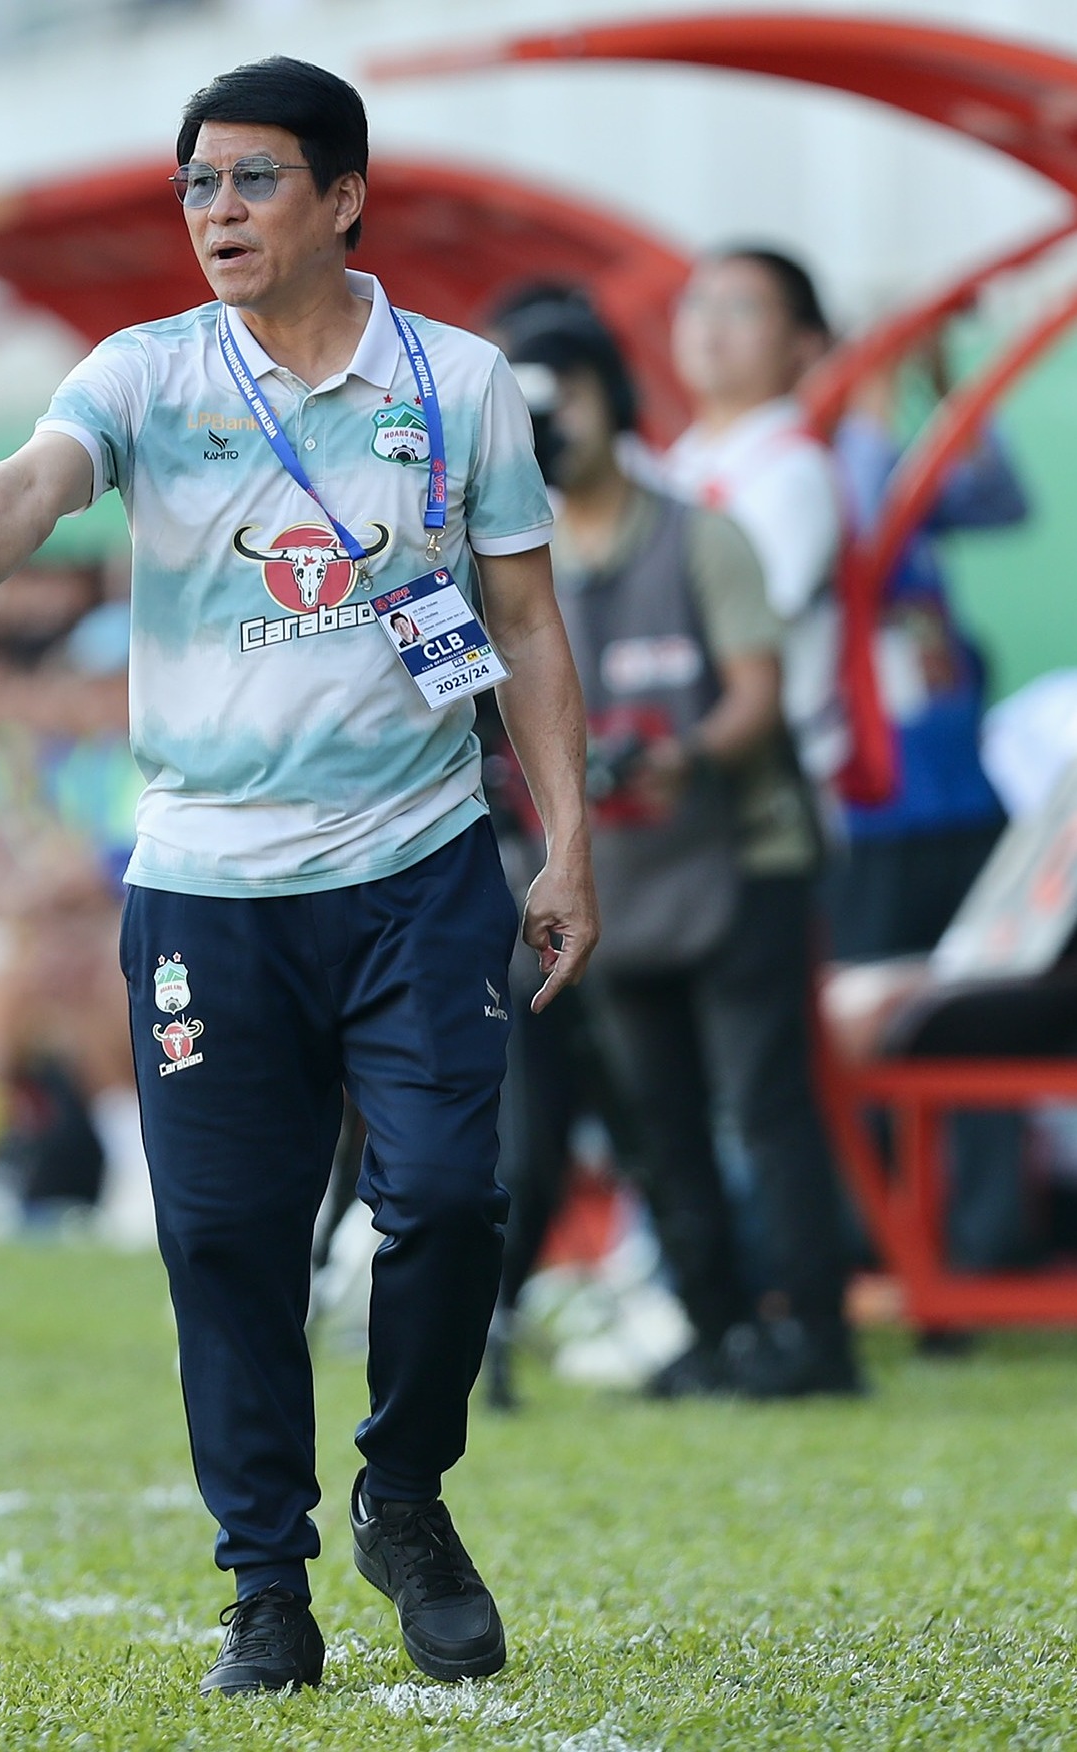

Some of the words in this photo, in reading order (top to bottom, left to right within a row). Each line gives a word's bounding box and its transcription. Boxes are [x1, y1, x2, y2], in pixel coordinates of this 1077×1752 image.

[222, 340, 258, 399] PROFESSIONAL
[413, 354, 433, 398] FOOTBALL
[251, 397, 278, 440] VIETNAM
[384, 430, 409, 440] HOANG
[409, 431, 424, 442] ANH
[203, 450, 239, 460] KAMITO
[432, 474, 445, 503] VPF
[384, 586, 411, 603] VPF
[240, 601, 378, 652] Carabao
[423, 632, 465, 660] CLB
[436, 664, 490, 695] 2023/24
[159, 1052, 203, 1077] Carabao
